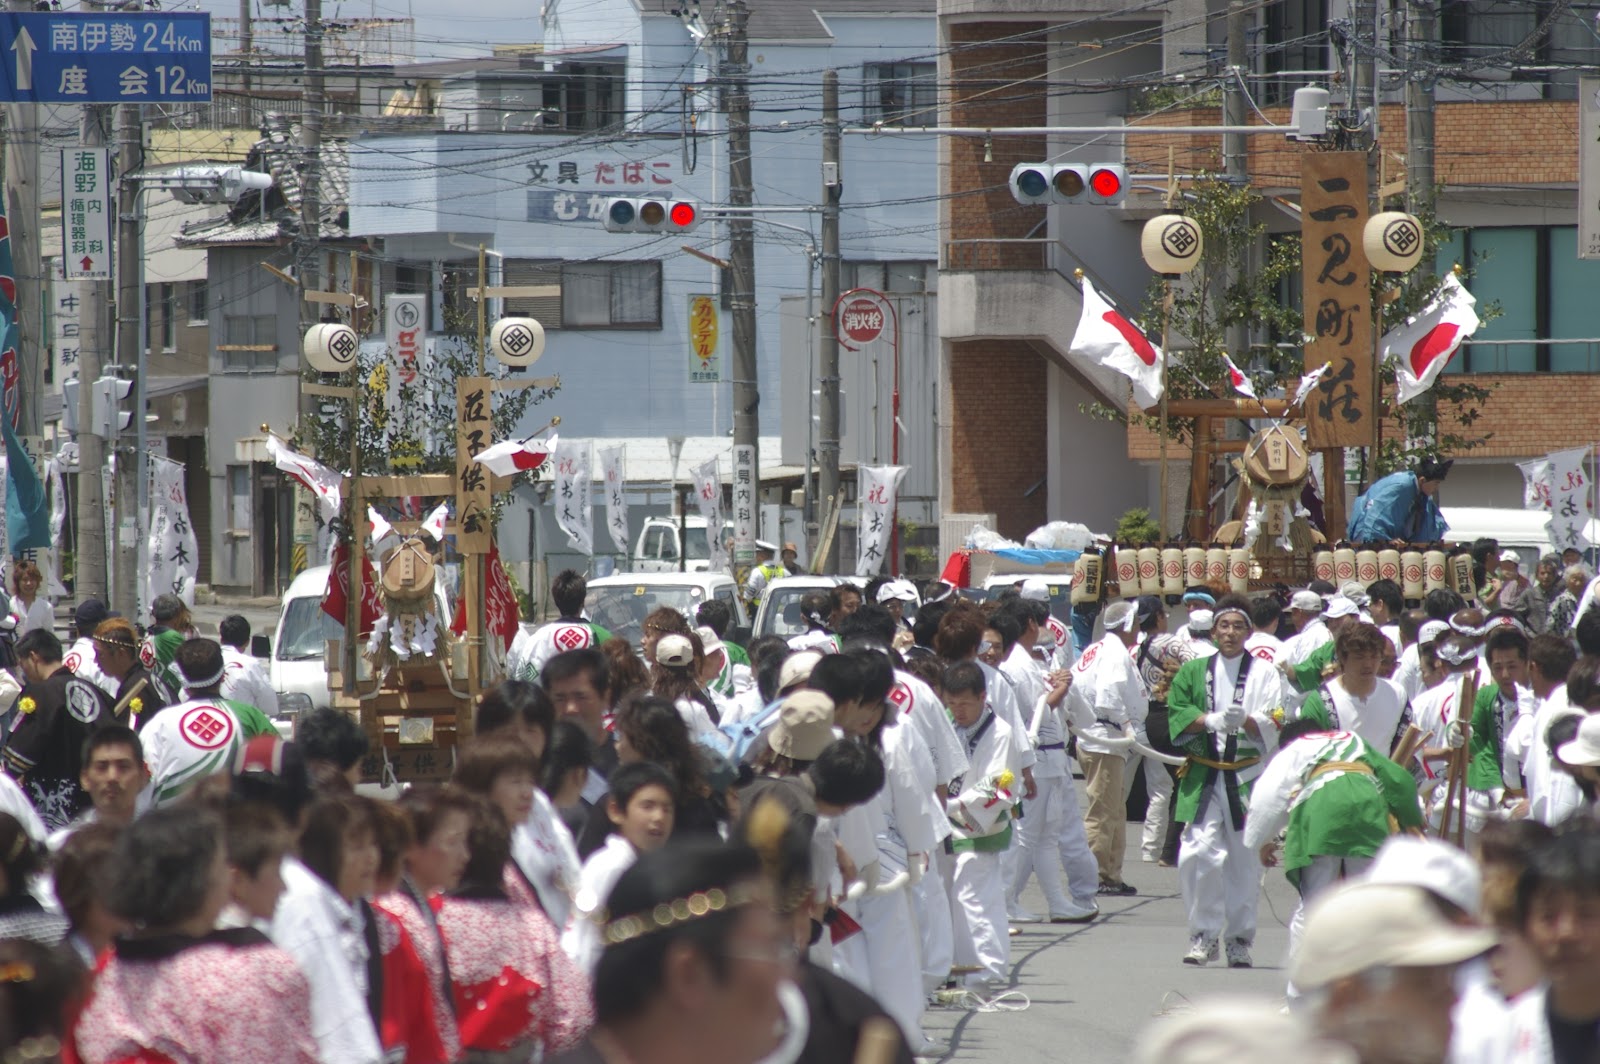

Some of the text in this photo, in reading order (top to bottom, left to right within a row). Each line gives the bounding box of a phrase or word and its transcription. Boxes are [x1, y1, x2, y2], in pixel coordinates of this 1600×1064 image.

[52, 22, 201, 51] 南伊勢 24Km
[155, 65, 208, 95] 12Km
[74, 151, 96, 193] 海野
[526, 160, 672, 184] 文具 たばこ
[70, 198, 86, 254] 循環器科
[87, 199, 103, 254] 内科
[60, 293, 80, 379] 中日新
[697, 304, 712, 356] カクテル
[845, 311, 882, 330] 消火栓
[737, 450, 751, 524] 鷲見内科
[864, 483, 888, 576] 祝お木
